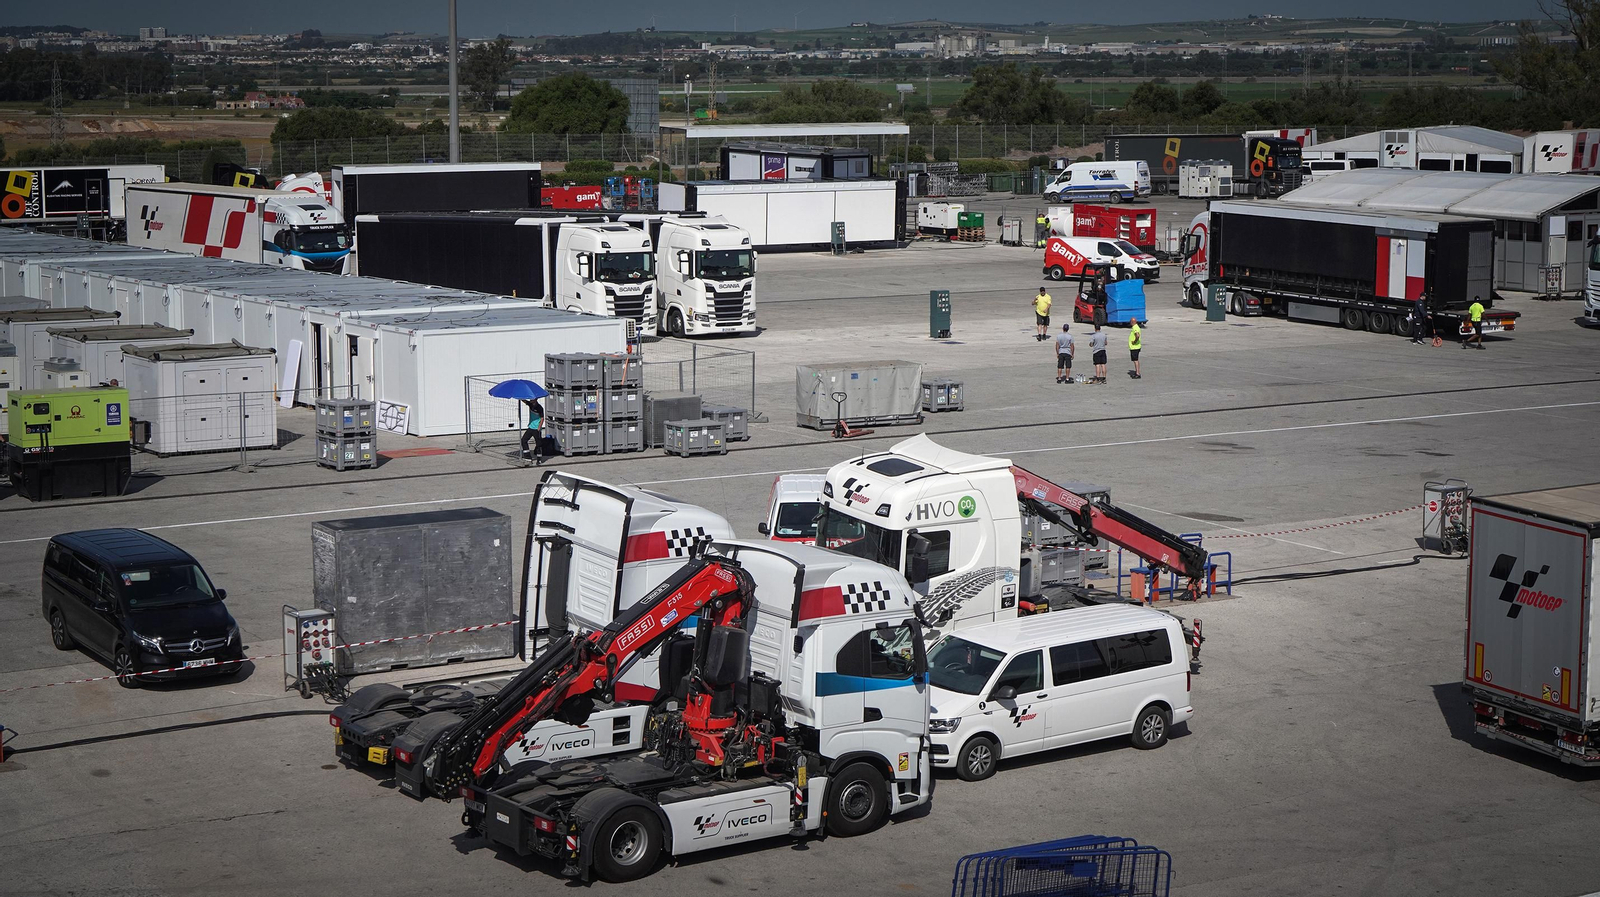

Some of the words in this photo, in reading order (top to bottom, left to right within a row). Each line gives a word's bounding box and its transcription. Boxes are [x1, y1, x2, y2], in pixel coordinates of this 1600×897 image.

[31, 171, 40, 217] CONTROL
[1076, 217, 1092, 226] gam
[1051, 241, 1076, 264] gam
[1060, 493, 1084, 509] FASS
[916, 500, 955, 520] HVO
[667, 592, 683, 608] F315
[620, 619, 653, 647] FASSI
[552, 739, 590, 751] IVECO
[728, 814, 767, 828] IVECO
